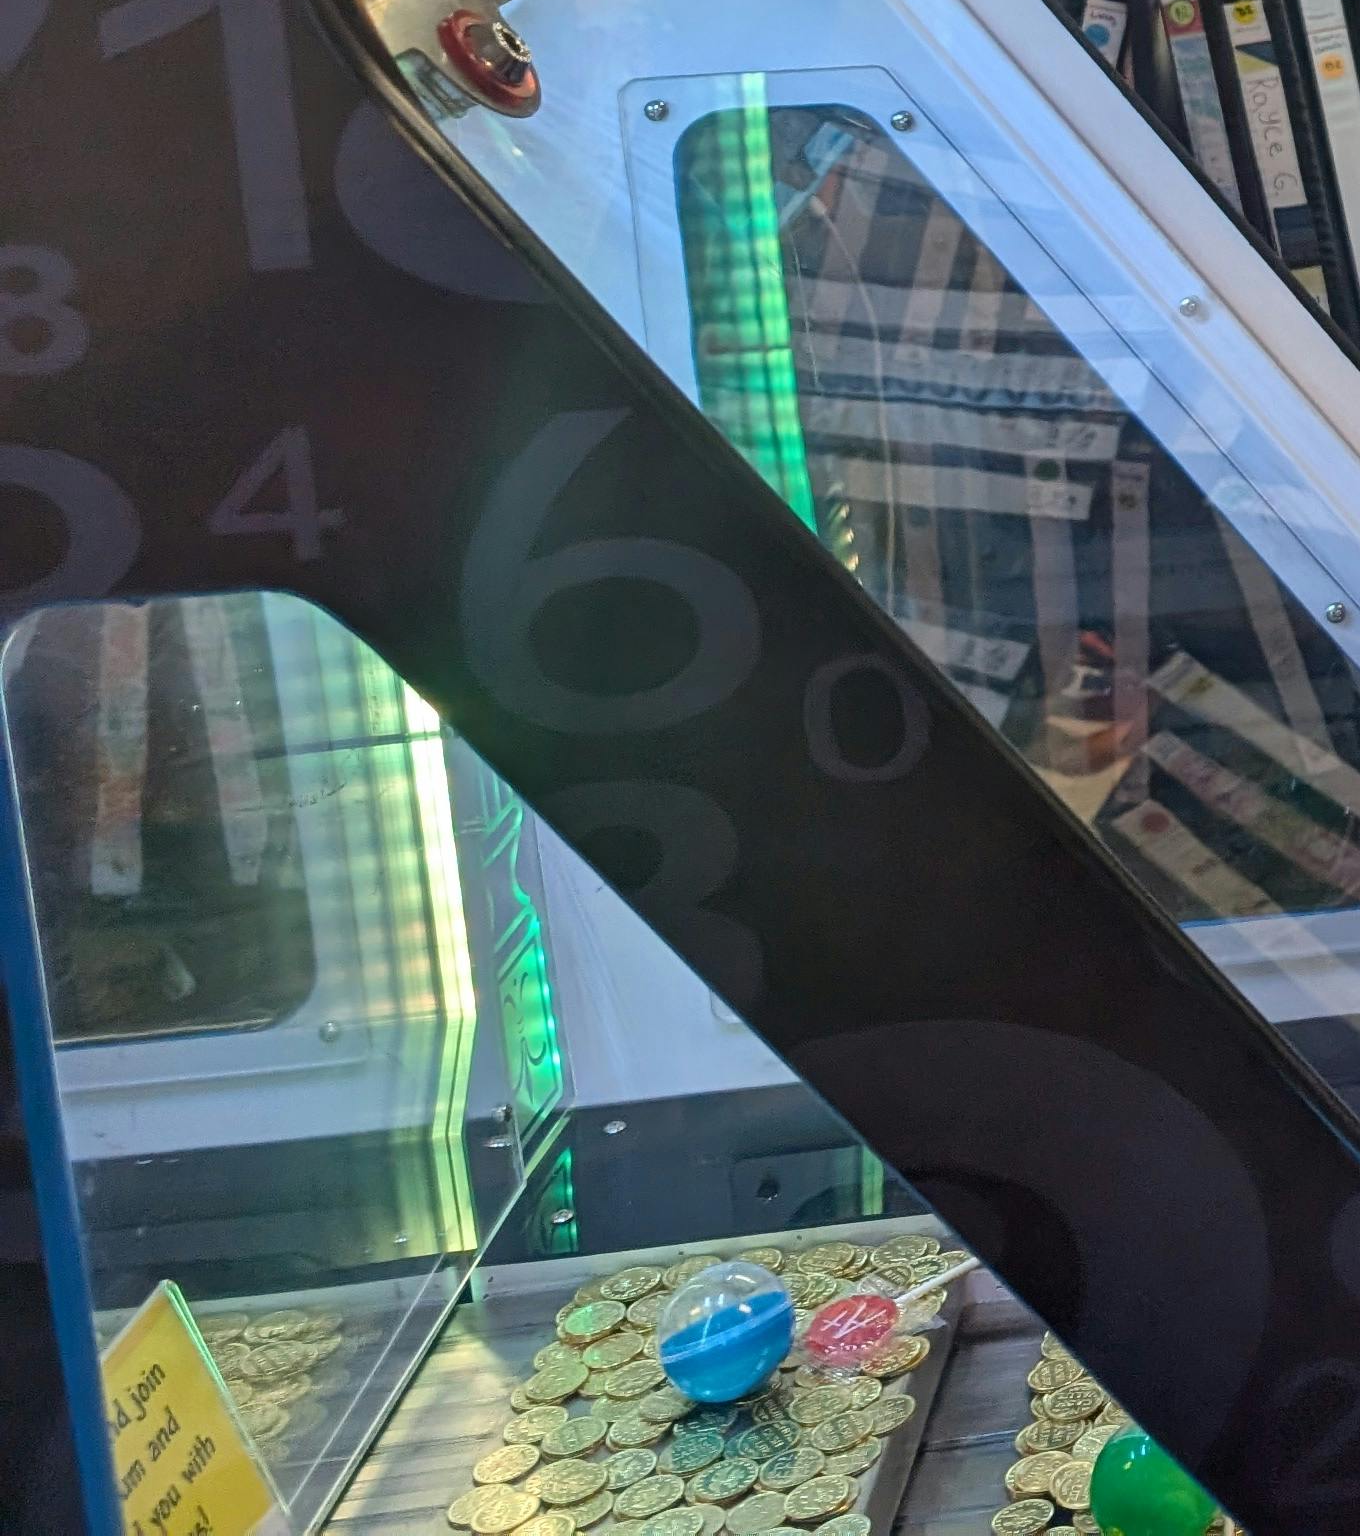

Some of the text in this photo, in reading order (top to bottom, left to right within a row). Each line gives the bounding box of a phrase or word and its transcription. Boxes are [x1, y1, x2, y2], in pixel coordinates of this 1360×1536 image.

[1247, 74, 1299, 199] Royce G.
[207, 425, 345, 564] 4
[458, 407, 763, 736] 6
[126, 1363, 167, 1422] join
[147, 1404, 181, 1462] and
[150, 1482, 182, 1536] you
[181, 1434, 217, 1485] with
